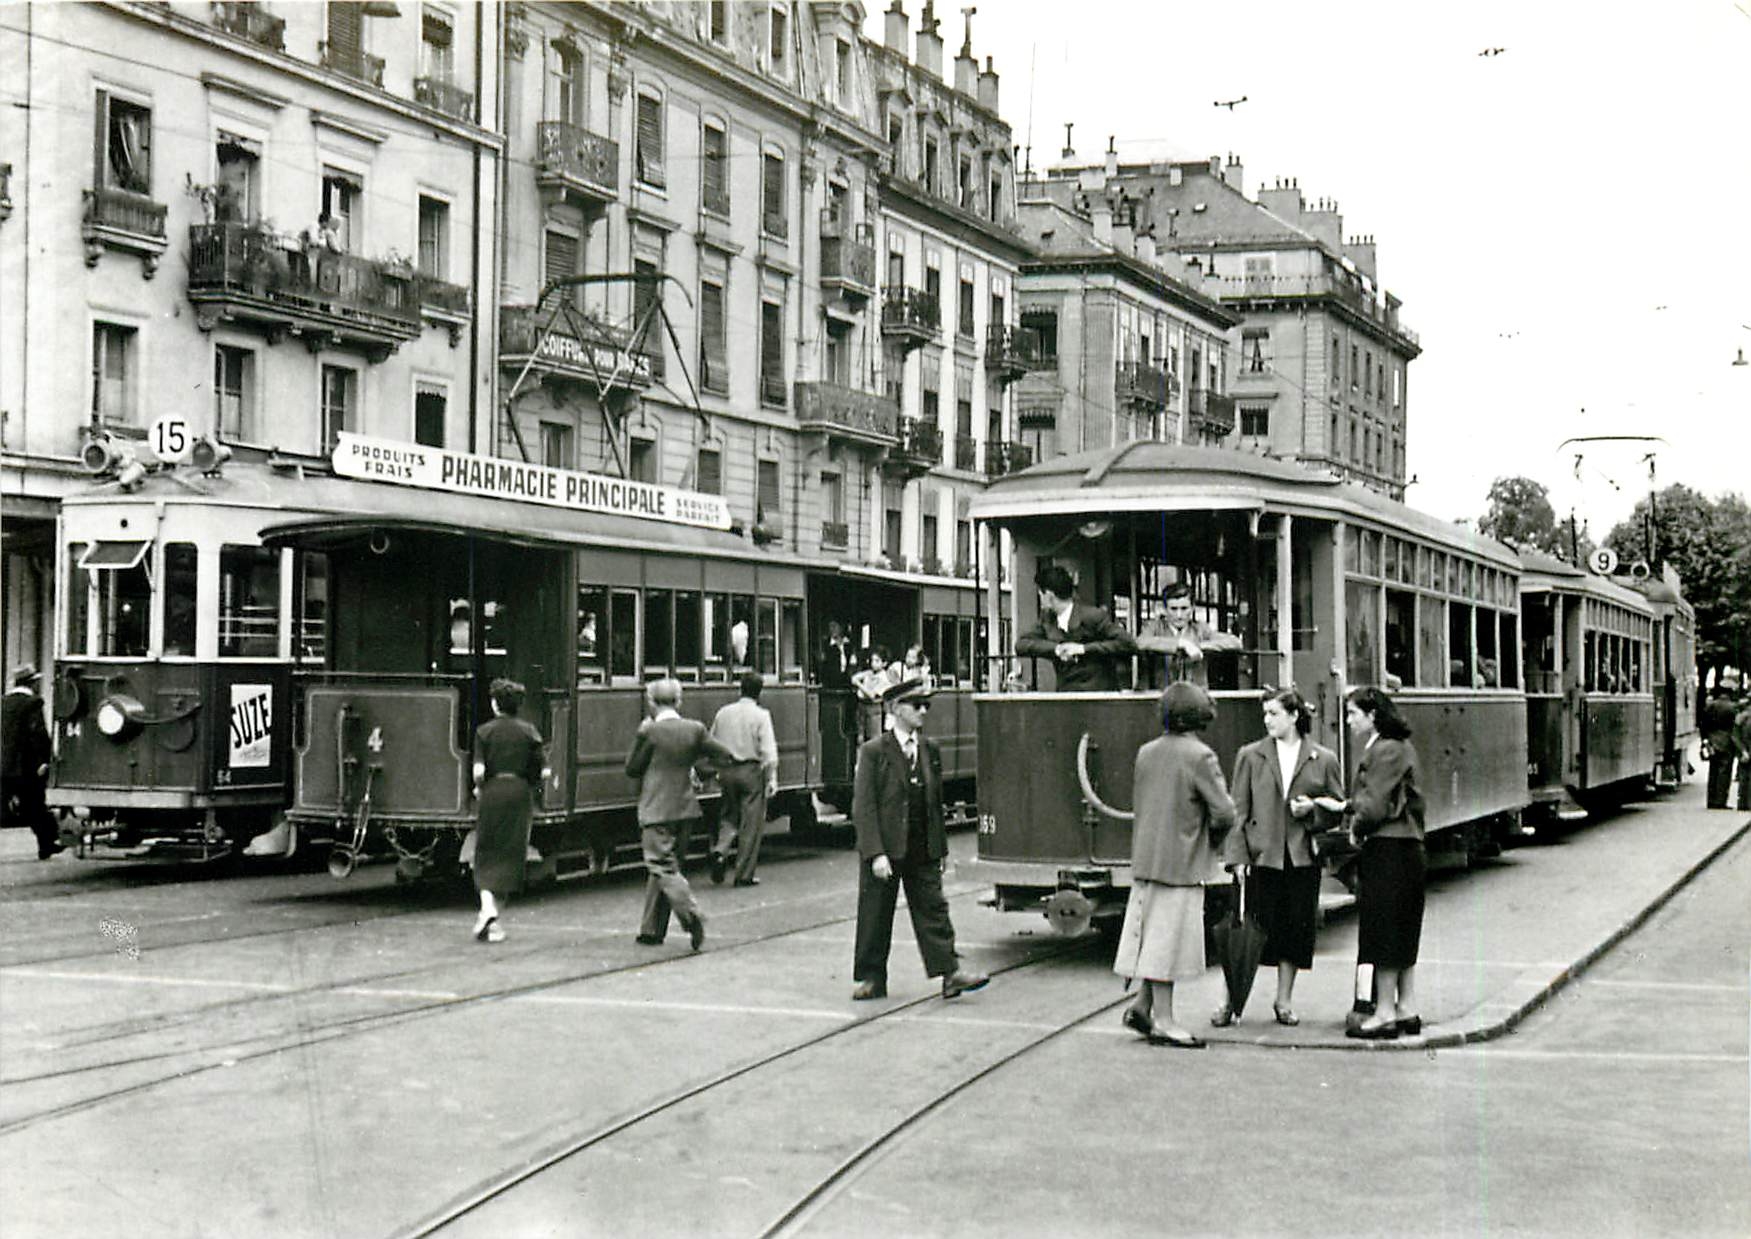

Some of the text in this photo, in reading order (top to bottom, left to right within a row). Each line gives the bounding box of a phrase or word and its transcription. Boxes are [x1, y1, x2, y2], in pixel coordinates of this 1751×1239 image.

[157, 422, 184, 453] 15
[352, 444, 425, 466] PRODUITS
[365, 461, 413, 478] FRAIS
[442, 455, 665, 516] PHARMACIE PRINCIPALE
[1598, 552, 1610, 571] 9
[230, 693, 272, 749] SUZE
[367, 727, 384, 751] 4
